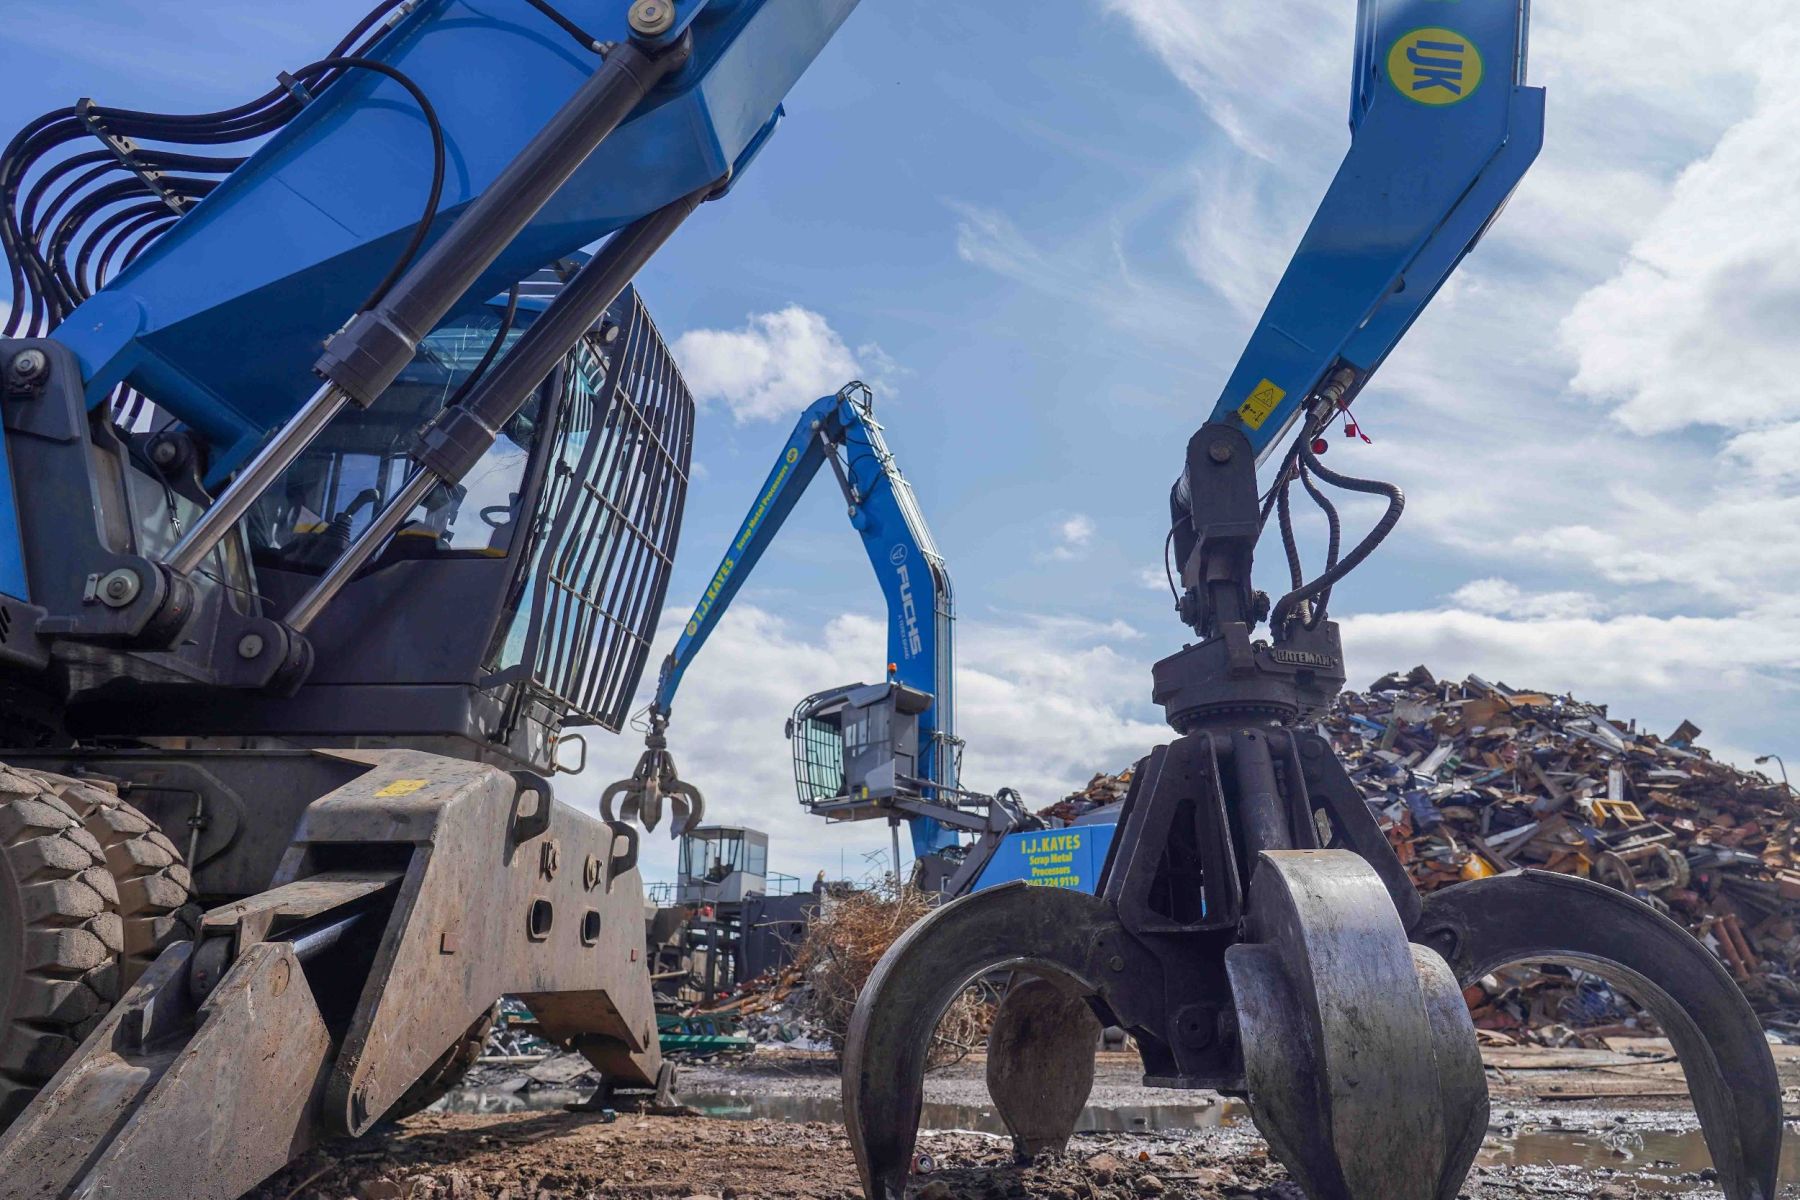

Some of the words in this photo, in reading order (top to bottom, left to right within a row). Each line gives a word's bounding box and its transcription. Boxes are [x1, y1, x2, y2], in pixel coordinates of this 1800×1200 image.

[1407, 40, 1464, 95] IJK
[695, 558, 734, 621] I.J.KAYES
[897, 564, 922, 655] FUCHS
[1277, 650, 1332, 667] BATEMAN
[1021, 834, 1081, 854] I.J.KAYES
[1029, 855, 1050, 866] Scrap
[1051, 852, 1073, 863] Metal
[1031, 866, 1071, 877] Processors
